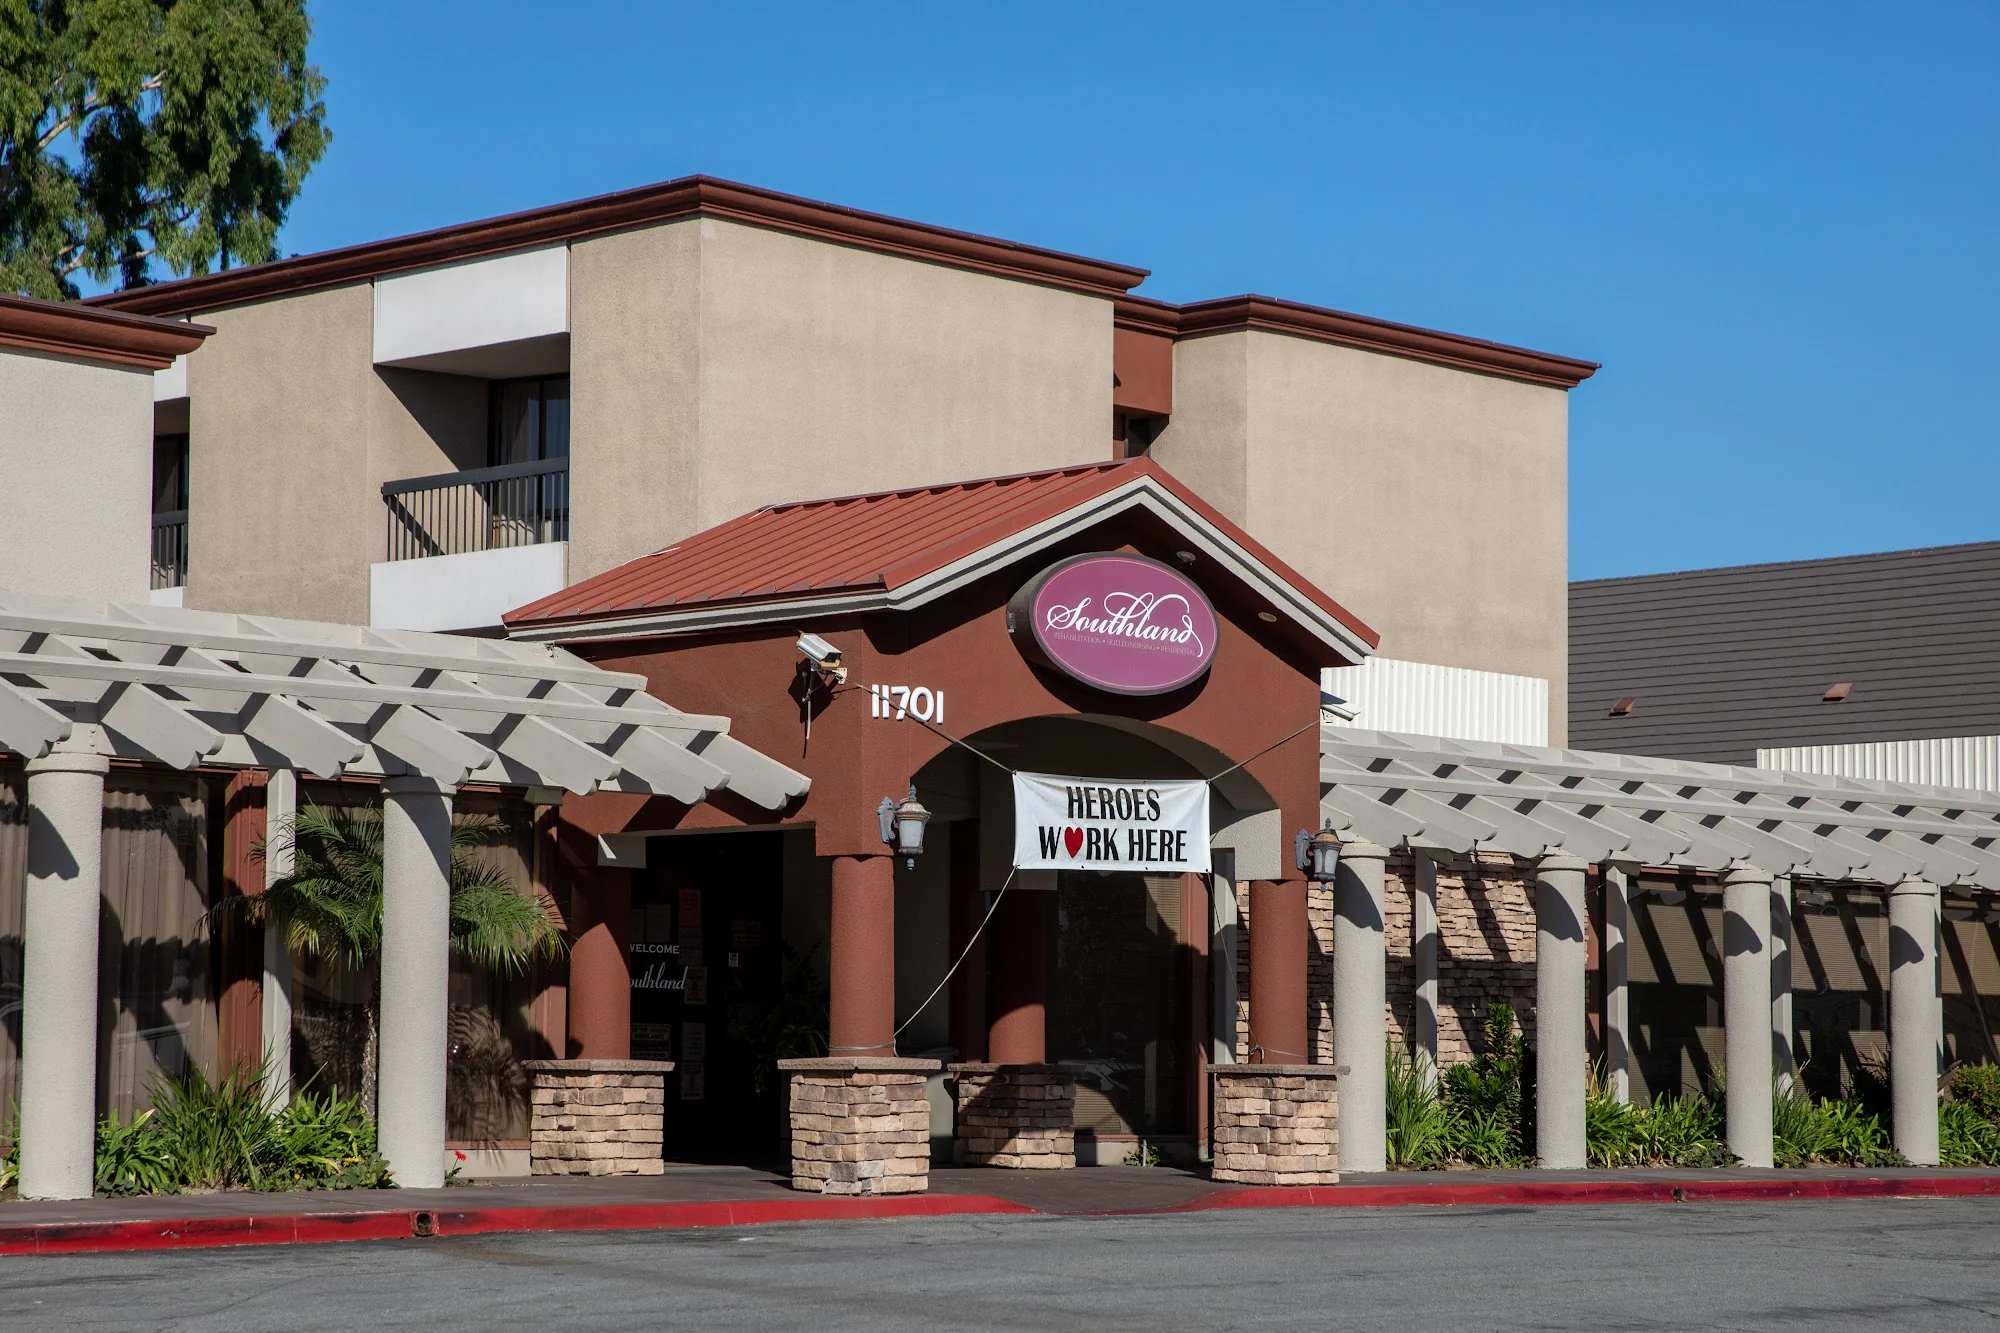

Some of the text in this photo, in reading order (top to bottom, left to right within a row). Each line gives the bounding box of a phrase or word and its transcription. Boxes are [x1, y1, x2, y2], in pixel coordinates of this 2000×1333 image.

[1045, 592, 1204, 658] Southland
[1053, 632, 1101, 644] REHABILITATION
[1160, 645, 1196, 656] RESIDENTIAL
[871, 684, 944, 724] 11701
[1066, 786, 1161, 822] HEROES
[1038, 826, 1188, 863] WRK HERE
[629, 961, 689, 990] outhland
